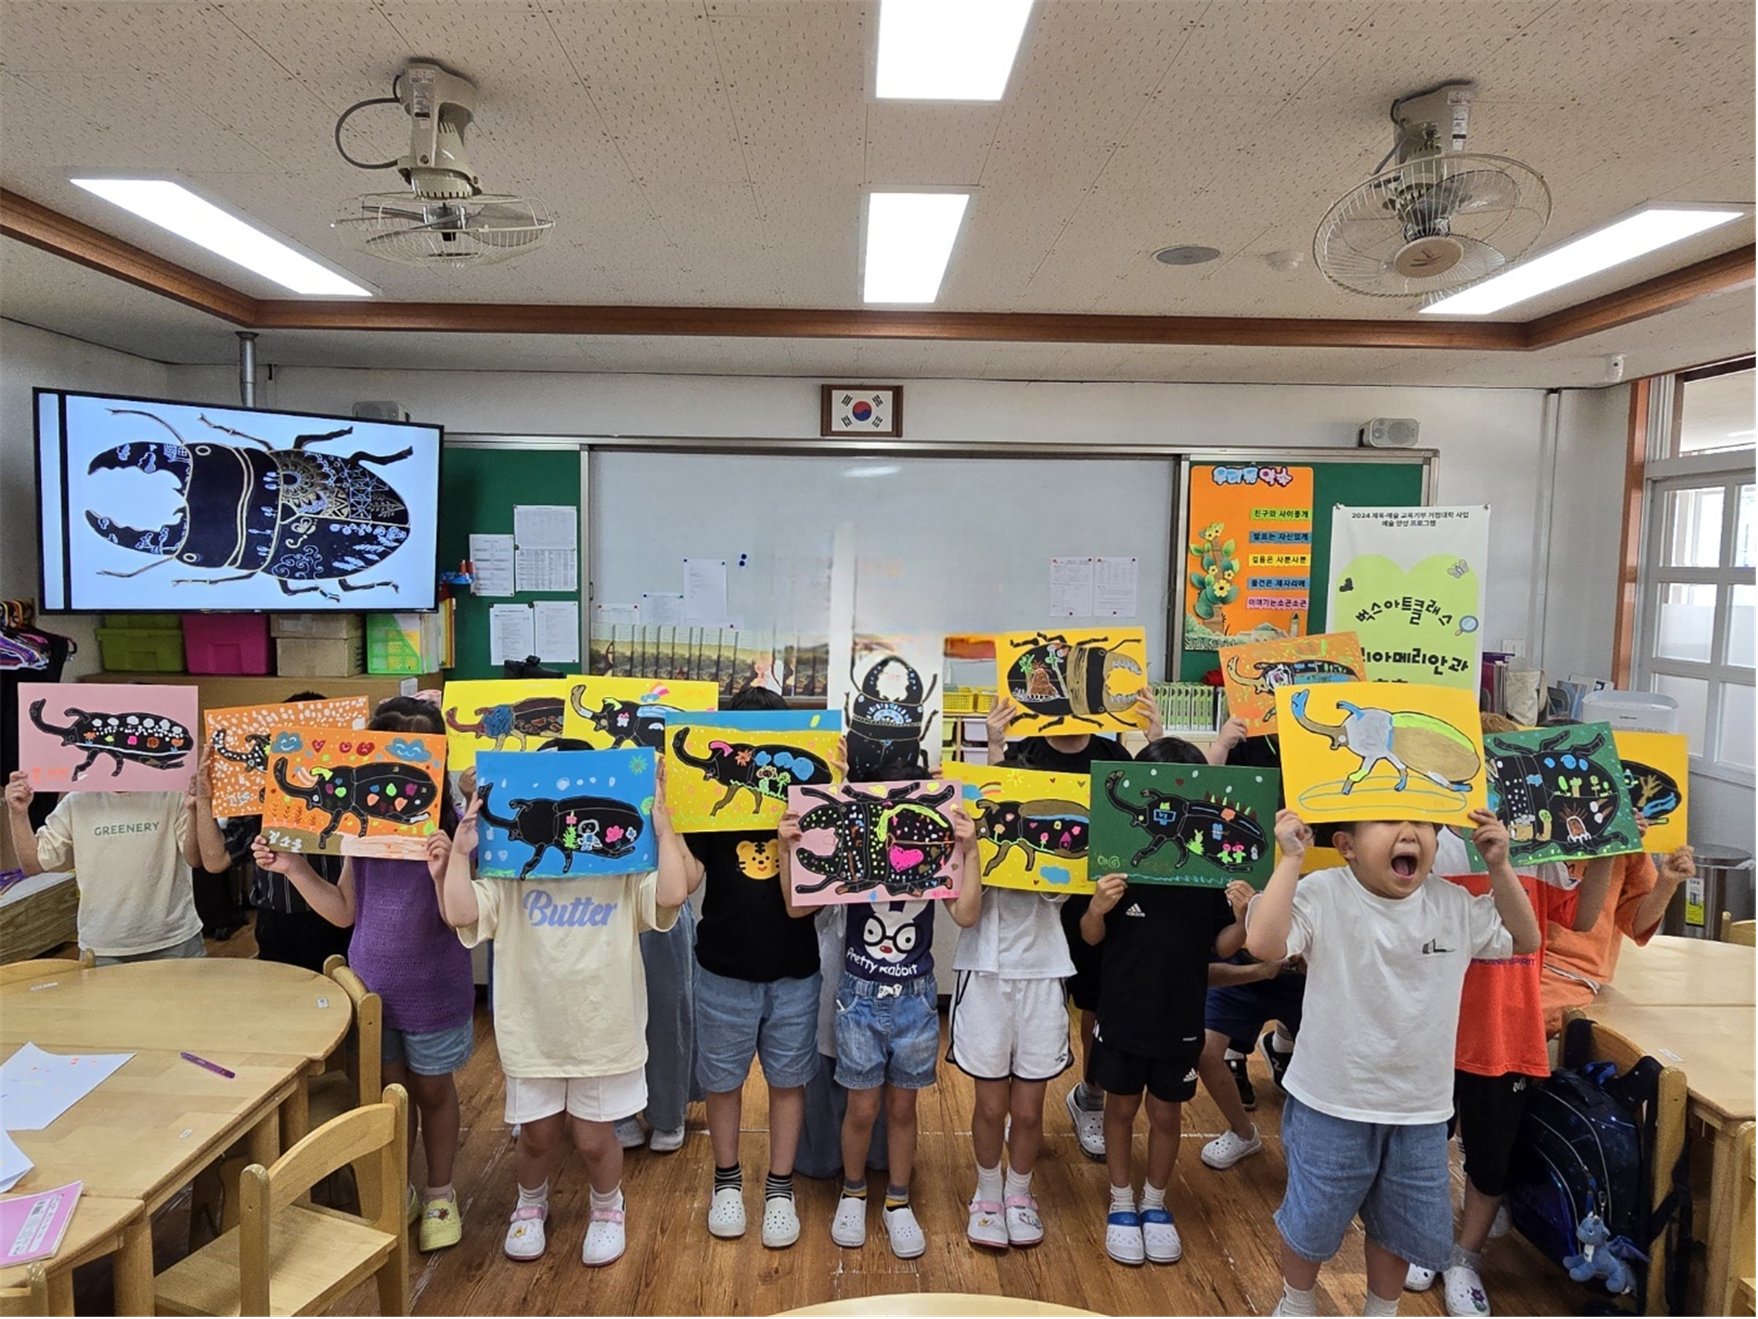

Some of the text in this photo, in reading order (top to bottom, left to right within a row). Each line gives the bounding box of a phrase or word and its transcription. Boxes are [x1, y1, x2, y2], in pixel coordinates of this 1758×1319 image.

[1254, 509, 1309, 518] 친구와 사이좋게
[1456, 511, 1470, 519] 사업
[1410, 520, 1437, 528] 프로그램
[1254, 532, 1277, 541] 발표는
[1276, 556, 1307, 564] 사뿐사뿐
[1275, 579, 1306, 588] 제자리에
[94, 821, 160, 836] GREENERY
[522, 889, 618, 927] Butter
